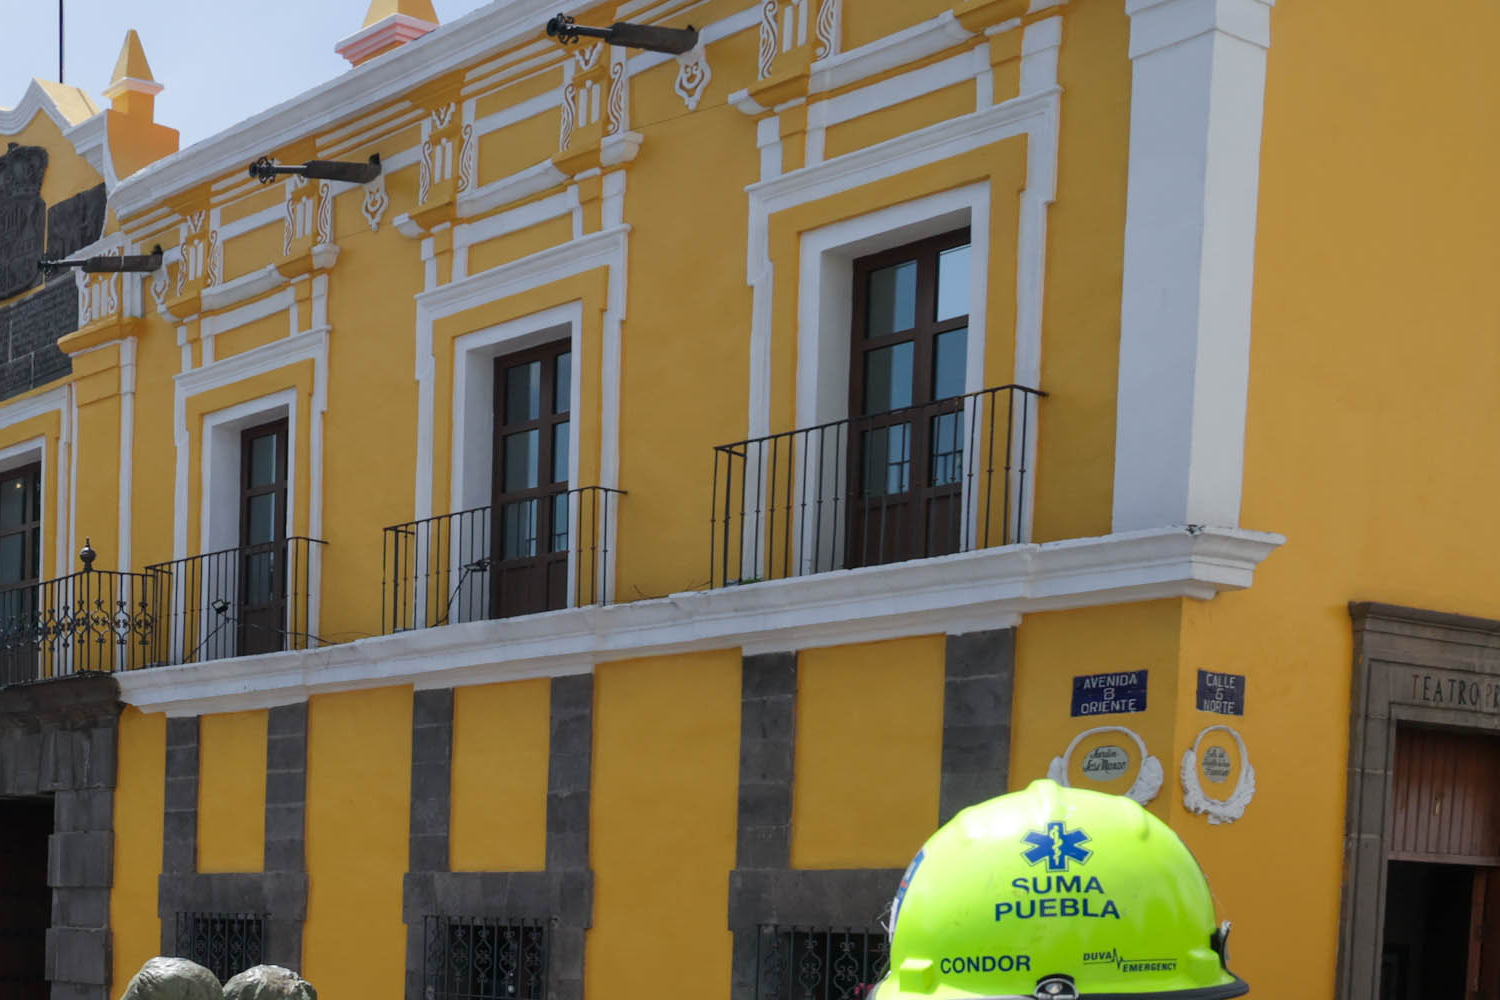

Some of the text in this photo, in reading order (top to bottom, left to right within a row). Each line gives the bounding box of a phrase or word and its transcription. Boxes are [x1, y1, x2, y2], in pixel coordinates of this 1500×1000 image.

[1083, 673, 1138, 690] AVENIDA
[1205, 673, 1236, 689] CALLE
[1215, 688, 1224, 700] 6
[1412, 674, 1480, 706] TEATRO
[1080, 699, 1137, 714] ORIENTE
[1203, 699, 1235, 714] NORTE
[1011, 875, 1105, 895] SUMA
[994, 897, 1121, 922] PUEBLA
[940, 954, 1031, 974] CONDOR
[1123, 962, 1177, 973] EMERGENCY
